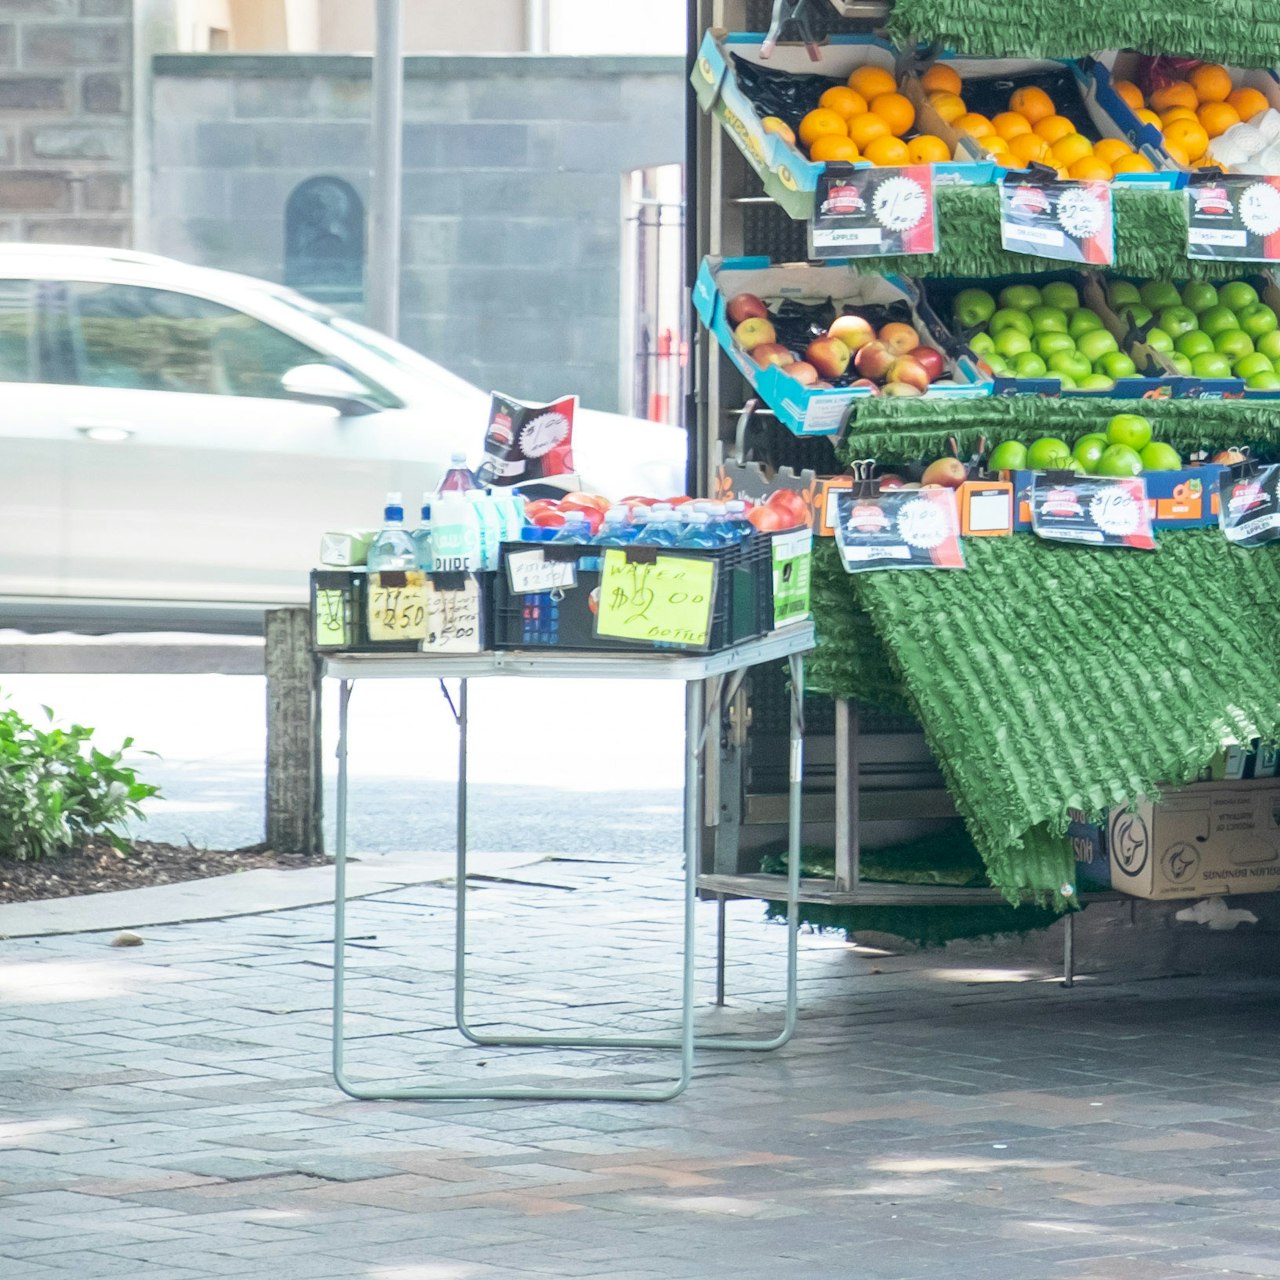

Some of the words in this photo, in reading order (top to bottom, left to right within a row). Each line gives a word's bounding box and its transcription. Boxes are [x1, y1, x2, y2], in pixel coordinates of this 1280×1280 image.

[608, 563, 687, 583] WATER
[648, 625, 709, 641] BOTTLE
[1202, 869, 1248, 881] BANANAS
